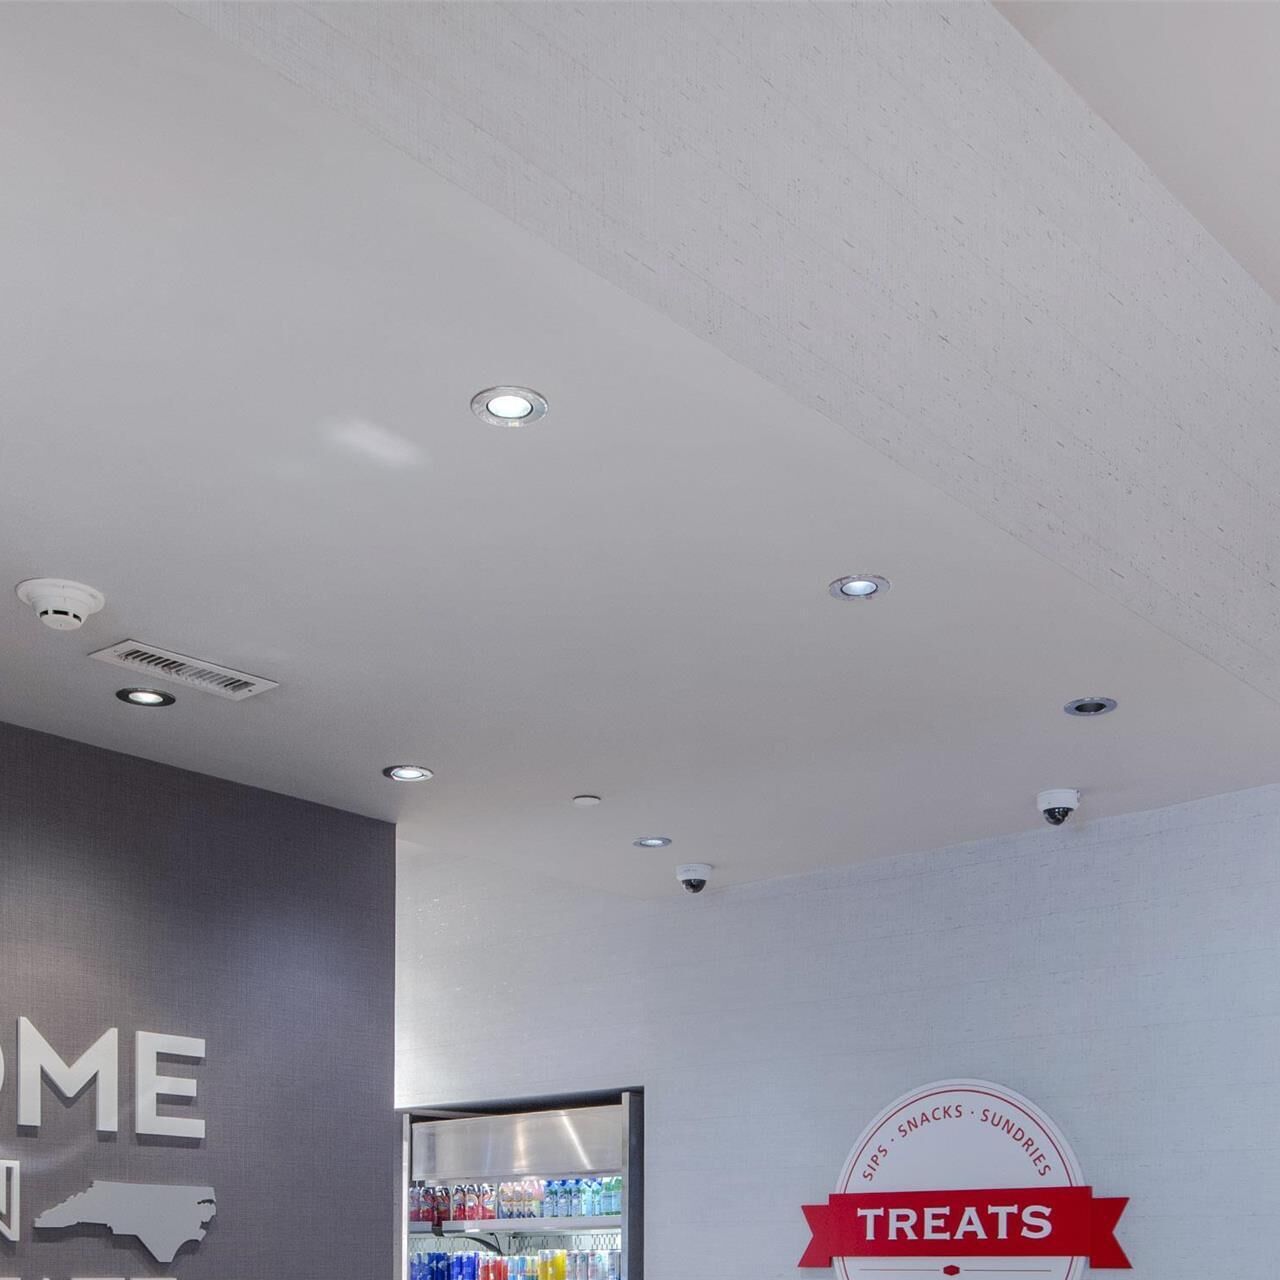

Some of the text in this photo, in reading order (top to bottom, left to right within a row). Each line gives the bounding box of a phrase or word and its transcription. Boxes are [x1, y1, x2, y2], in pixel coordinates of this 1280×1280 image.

[862, 1104, 1052, 1181] SIPS SNACKS SUNDRIES
[857, 1204, 1053, 1240] TREATS
